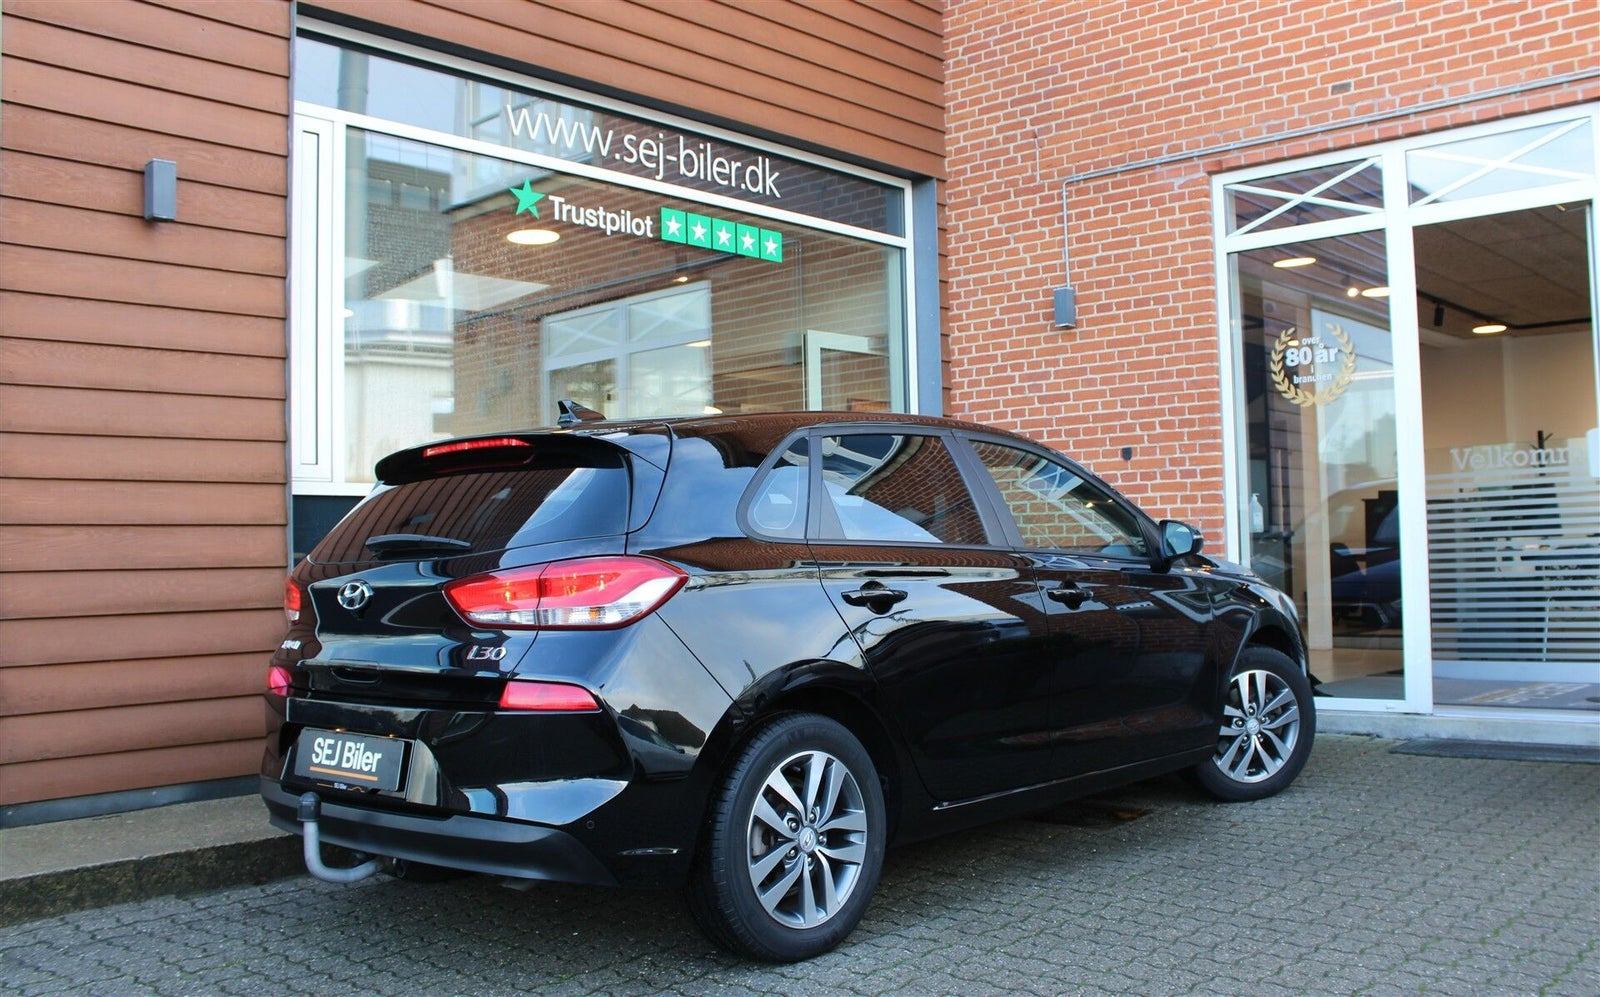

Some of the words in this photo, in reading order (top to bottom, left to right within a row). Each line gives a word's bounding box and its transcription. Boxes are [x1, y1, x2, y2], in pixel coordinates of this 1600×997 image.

[507, 103, 782, 198] www.sej-biler.dk
[548, 195, 653, 238] Trustpilot
[1285, 347, 1312, 367] 80
[1315, 342, 1338, 363] år
[1302, 336, 1321, 346] over
[312, 737, 343, 767] SEJ
[342, 741, 382, 773] Biler
